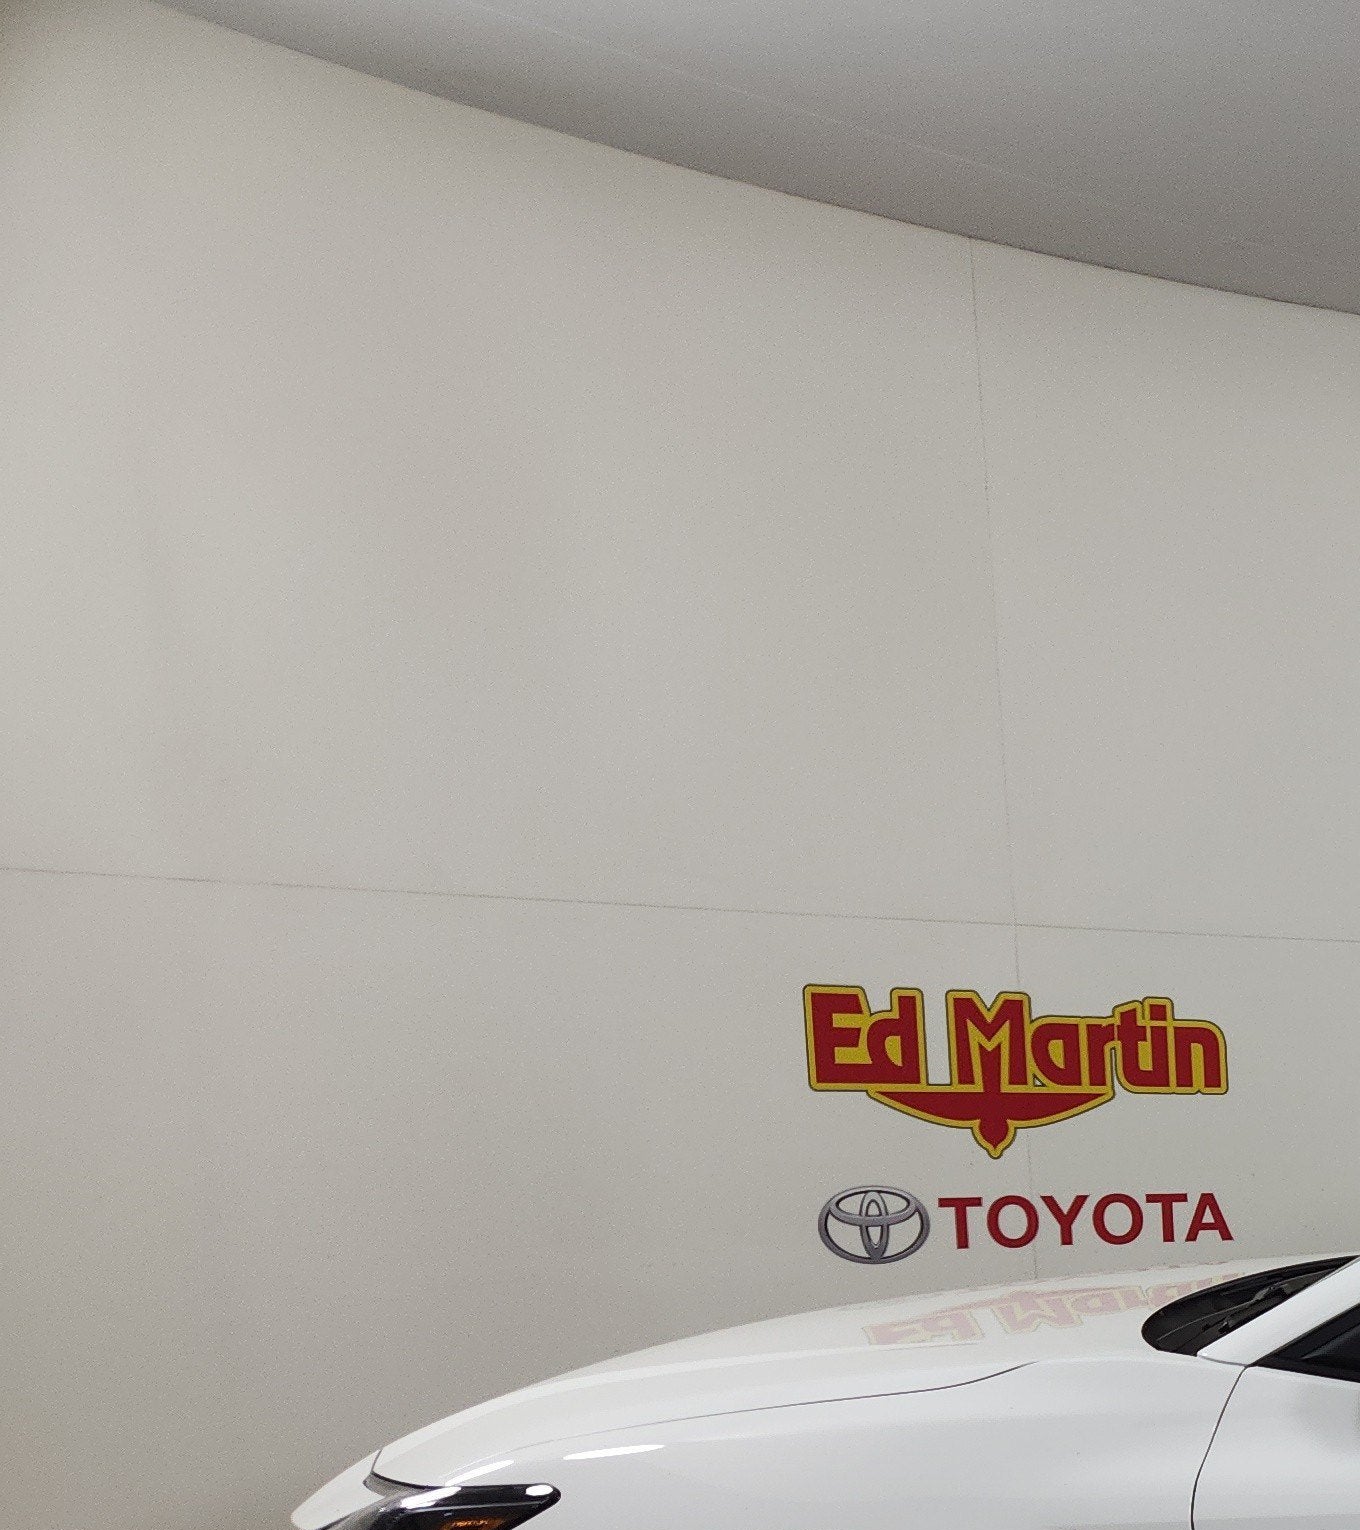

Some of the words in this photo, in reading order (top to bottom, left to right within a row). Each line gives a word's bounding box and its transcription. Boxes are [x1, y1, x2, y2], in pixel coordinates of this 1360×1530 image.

[804, 985, 926, 1092] Ed
[945, 990, 1229, 1095] Martin
[938, 1193, 1233, 1250] TOYOTA
